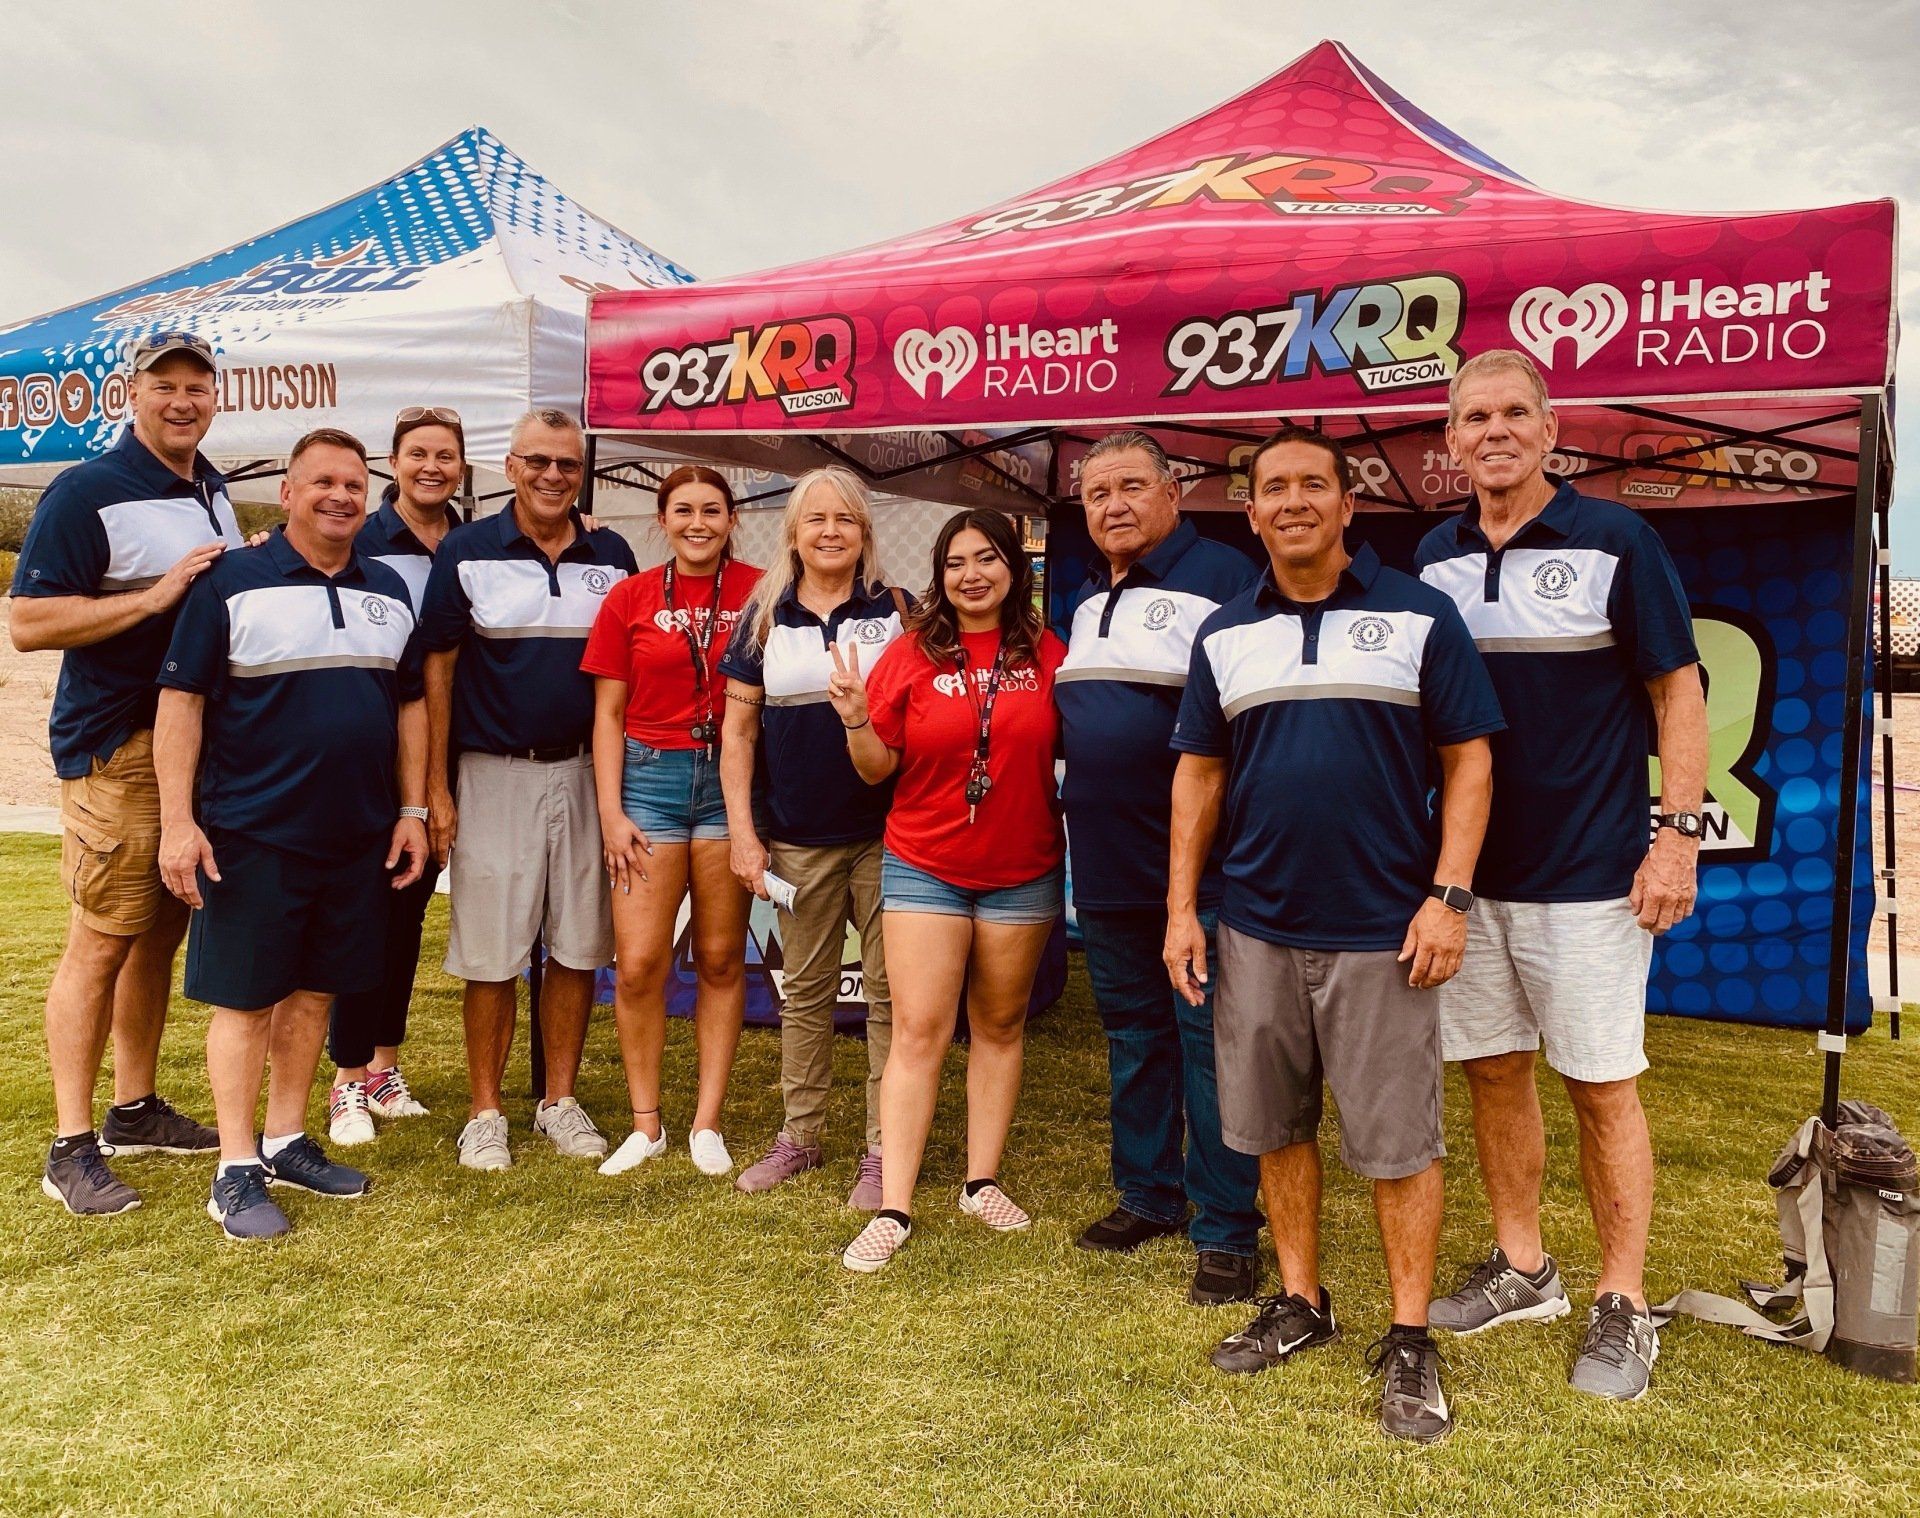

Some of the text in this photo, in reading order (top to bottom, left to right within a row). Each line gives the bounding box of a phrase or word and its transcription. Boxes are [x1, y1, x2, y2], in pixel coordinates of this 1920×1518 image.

[1290, 203, 1430, 213] TUCSON
[218, 263, 429, 296] BULL
[240, 297, 351, 311] COUNTRY
[1640, 271, 1831, 322] iHeart
[985, 319, 1119, 360] iHeart
[1637, 319, 1826, 367] RADIO
[984, 359, 1118, 398] RADIO
[1367, 363, 1445, 386] TUCSON
[788, 391, 843, 410] TUCSON
